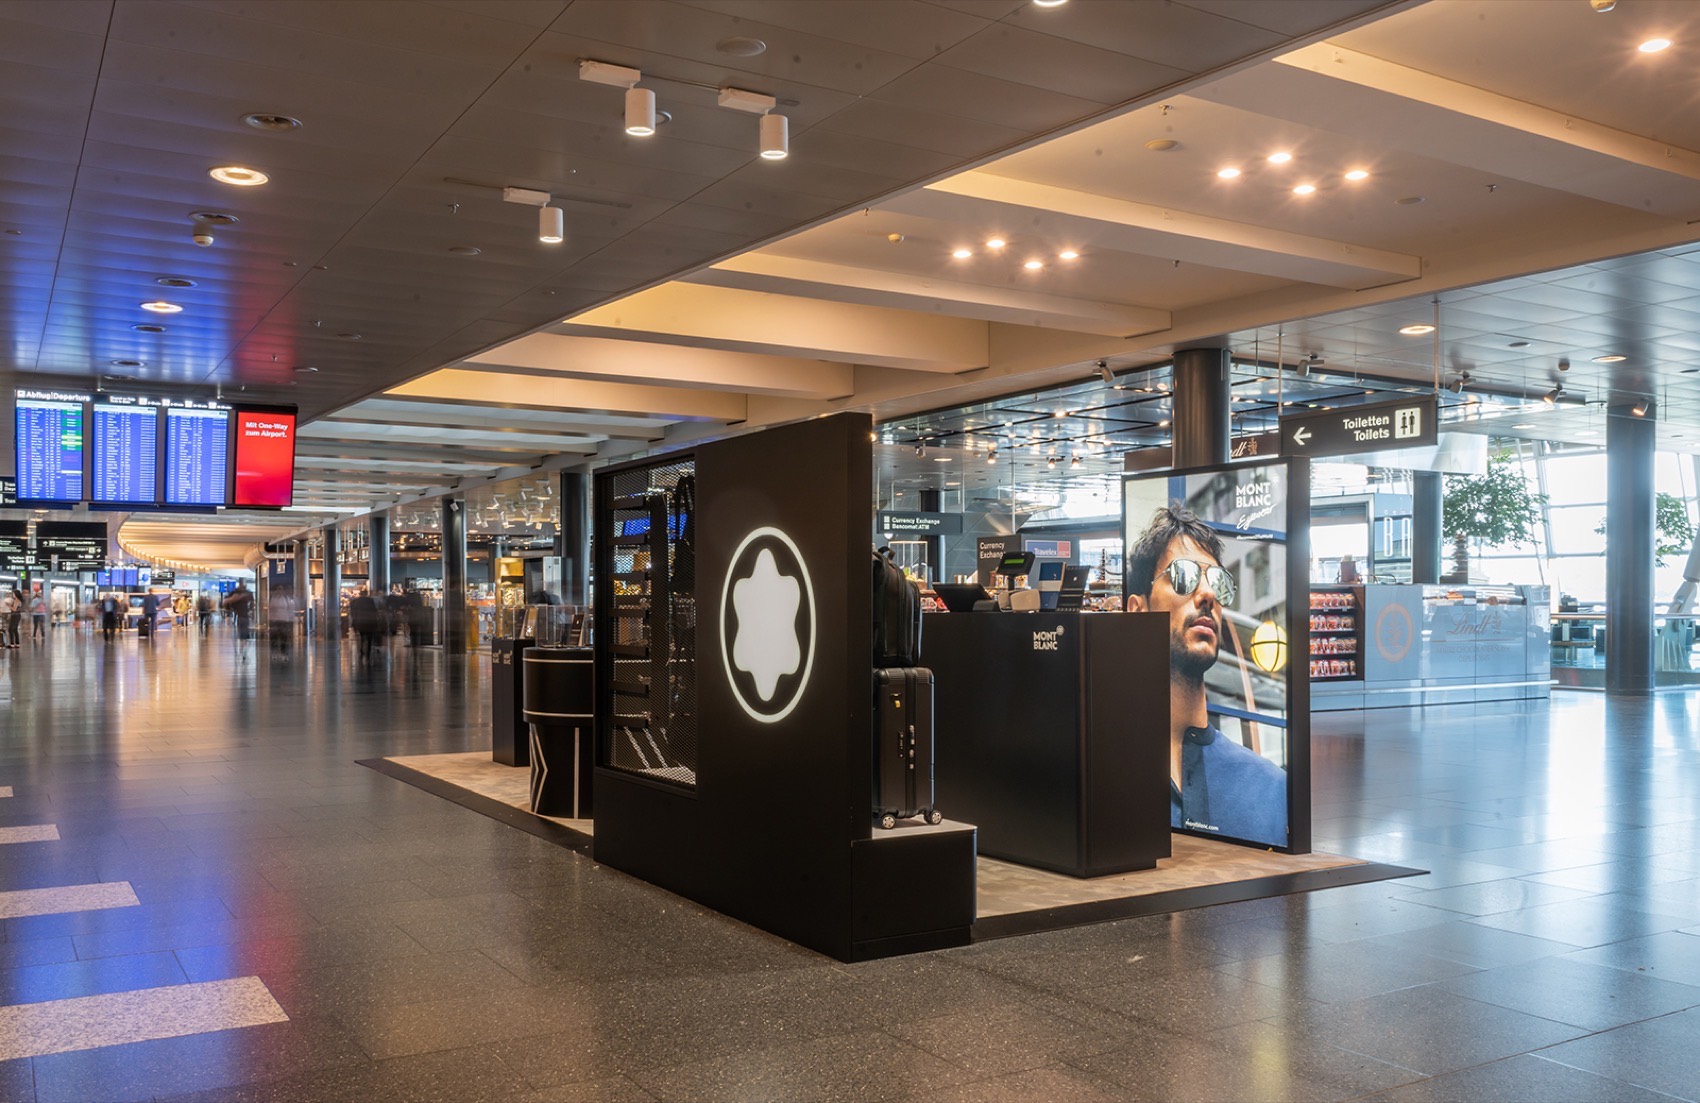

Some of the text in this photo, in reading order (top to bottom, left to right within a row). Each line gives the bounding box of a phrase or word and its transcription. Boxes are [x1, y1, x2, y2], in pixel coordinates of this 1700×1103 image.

[245, 421, 289, 431] Mit One-Way
[1342, 415, 1390, 430] Toiletten
[260, 430, 288, 438] Airport.
[1353, 428, 1390, 442] Toilets
[1236, 482, 1271, 496] MONT
[1235, 494, 1272, 508] BLANC
[980, 541, 1006, 550] Currency
[980, 550, 1006, 560] Exchang
[1033, 547, 1057, 557] Travelex
[1447, 611, 1492, 635] Lindt
[1033, 631, 1057, 641] MONT
[1033, 641, 1058, 650] BLANC
